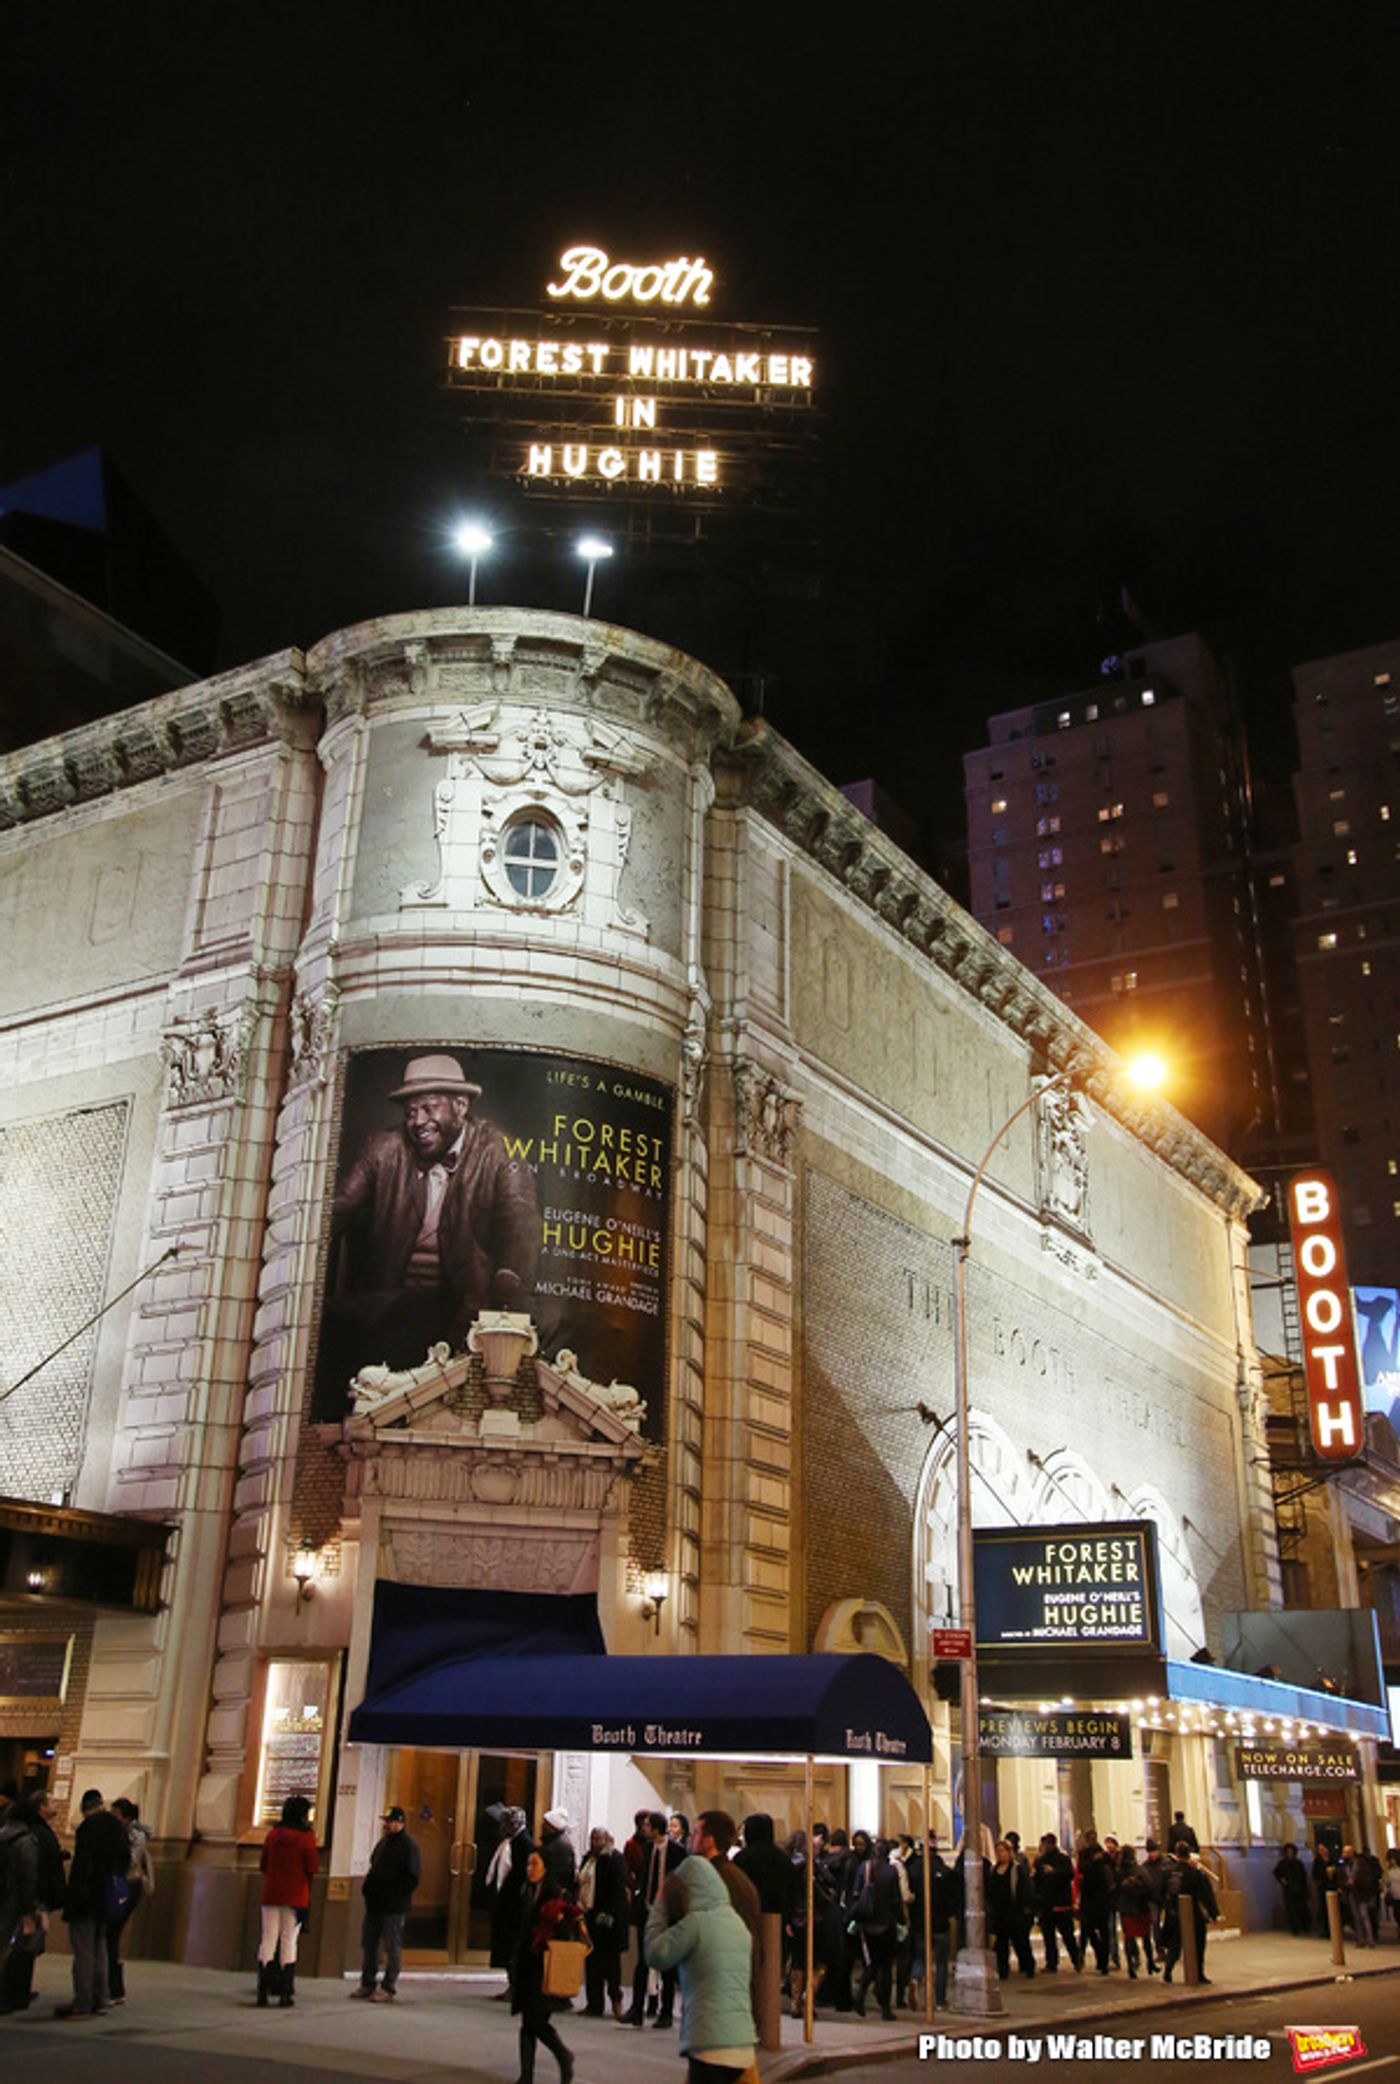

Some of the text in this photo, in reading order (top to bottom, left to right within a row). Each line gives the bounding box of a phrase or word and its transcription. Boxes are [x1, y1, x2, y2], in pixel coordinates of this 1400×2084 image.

[547, 246, 714, 305] Booth
[459, 336, 813, 387] FOREST WHITAKER
[615, 396, 656, 428] IN
[529, 444, 719, 483] HUGHIE
[547, 1071, 590, 1089] LIFE'S
[596, 1081, 607, 1093] A
[554, 1115, 663, 1161] FOREST
[503, 1136, 662, 1189] WHITAKER
[508, 1161, 538, 1174] ON
[543, 1206, 661, 1243] EUGENE O'NEILL'S
[543, 1221, 660, 1268] HUGHIE
[535, 1281, 592, 1301] MICHAEL
[595, 1290, 659, 1317] GRANDAGE
[1294, 1181, 1355, 1447] BOOTH
[1045, 1541, 1137, 1564] FOREST
[1012, 1563, 1139, 1585] WHITAKER
[1044, 1592, 1086, 1604] EUGENE
[1044, 1603, 1142, 1625] HUGHIE
[1032, 1626, 1078, 1637] MICHAEL
[1081, 1624, 1143, 1637] GRANDAGE
[592, 1724, 702, 1746] Booth Theatre
[979, 1719, 1119, 1734] PREVIEWS BEGIN
[978, 1735, 1120, 1749] MONDAY FEBRUARY 8
[1241, 1752, 1353, 1766] NOW ON SALE
[1243, 1763, 1357, 1777] TELECHARGE.COM
